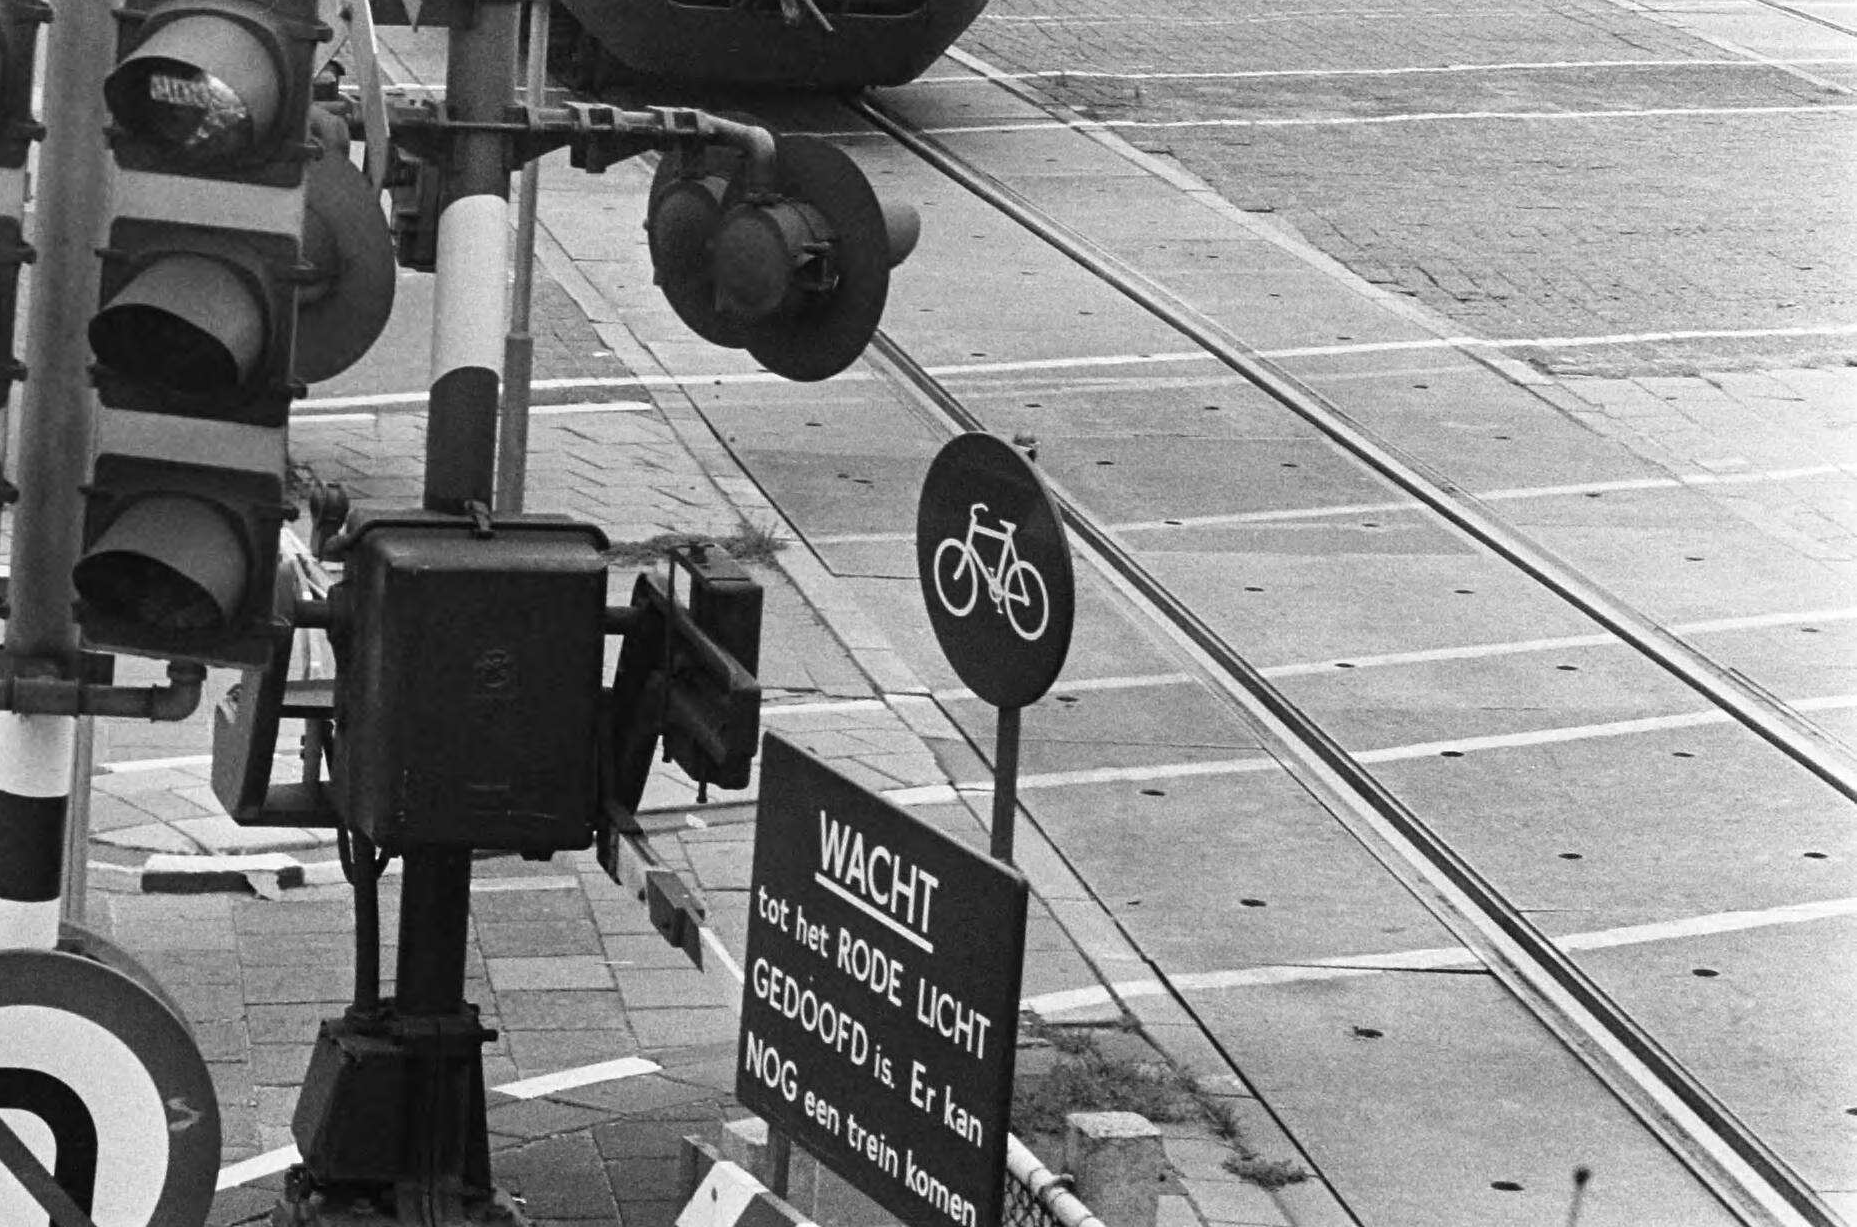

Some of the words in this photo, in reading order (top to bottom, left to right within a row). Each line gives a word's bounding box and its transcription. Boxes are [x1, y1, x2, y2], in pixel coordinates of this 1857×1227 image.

[820, 809, 939, 933] WACHT
[753, 957, 869, 1066] GEDOOFD
[873, 1044, 895, 1089] is.
[910, 1060, 936, 1113] Er
[944, 1085, 983, 1148] kan
[758, 885, 790, 933] tot
[796, 905, 830, 958] het
[838, 927, 904, 1007] RODE
[917, 978, 991, 1060] LICHT
[745, 1031, 798, 1102] NOG
[804, 1090, 840, 1136] een
[847, 1113, 899, 1178] trein
[905, 1149, 976, 1227] komen
